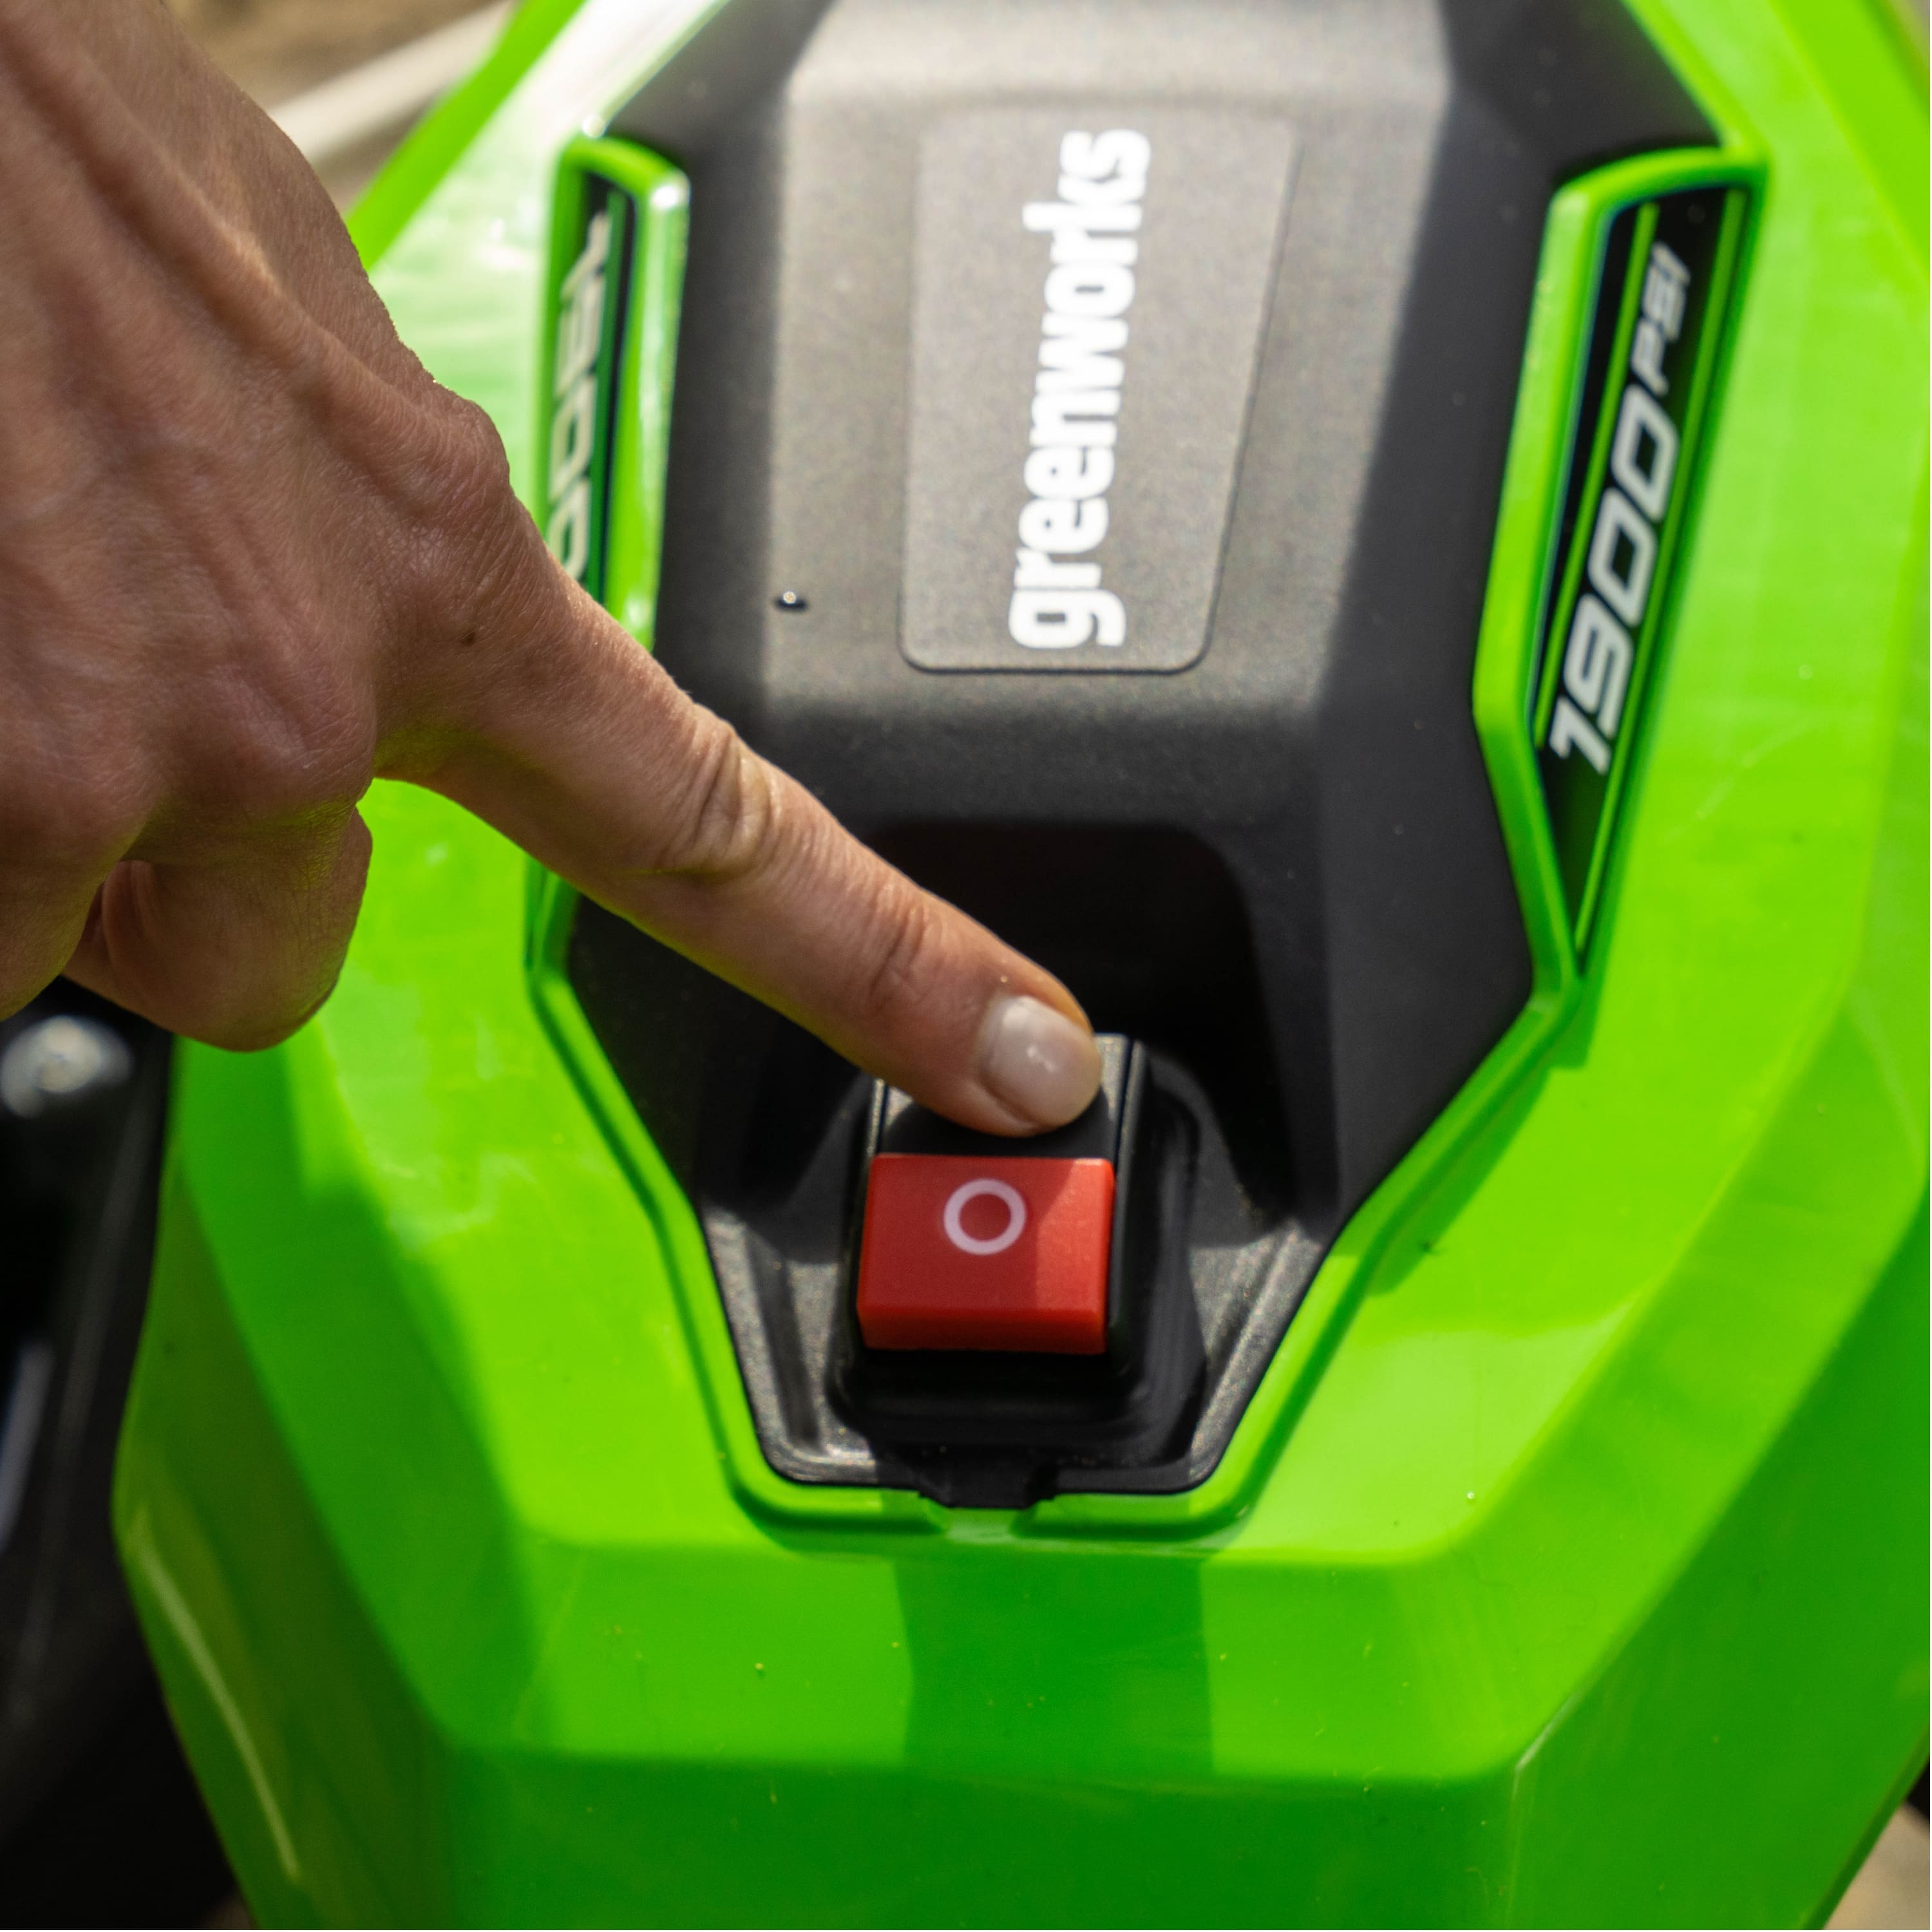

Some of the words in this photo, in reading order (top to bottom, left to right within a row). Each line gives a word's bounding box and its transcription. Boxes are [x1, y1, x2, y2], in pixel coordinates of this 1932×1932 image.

[1009, 129, 1151, 648] greenworks
[1549, 383, 1679, 775] 1900
[1629, 240, 1691, 397] PSI
